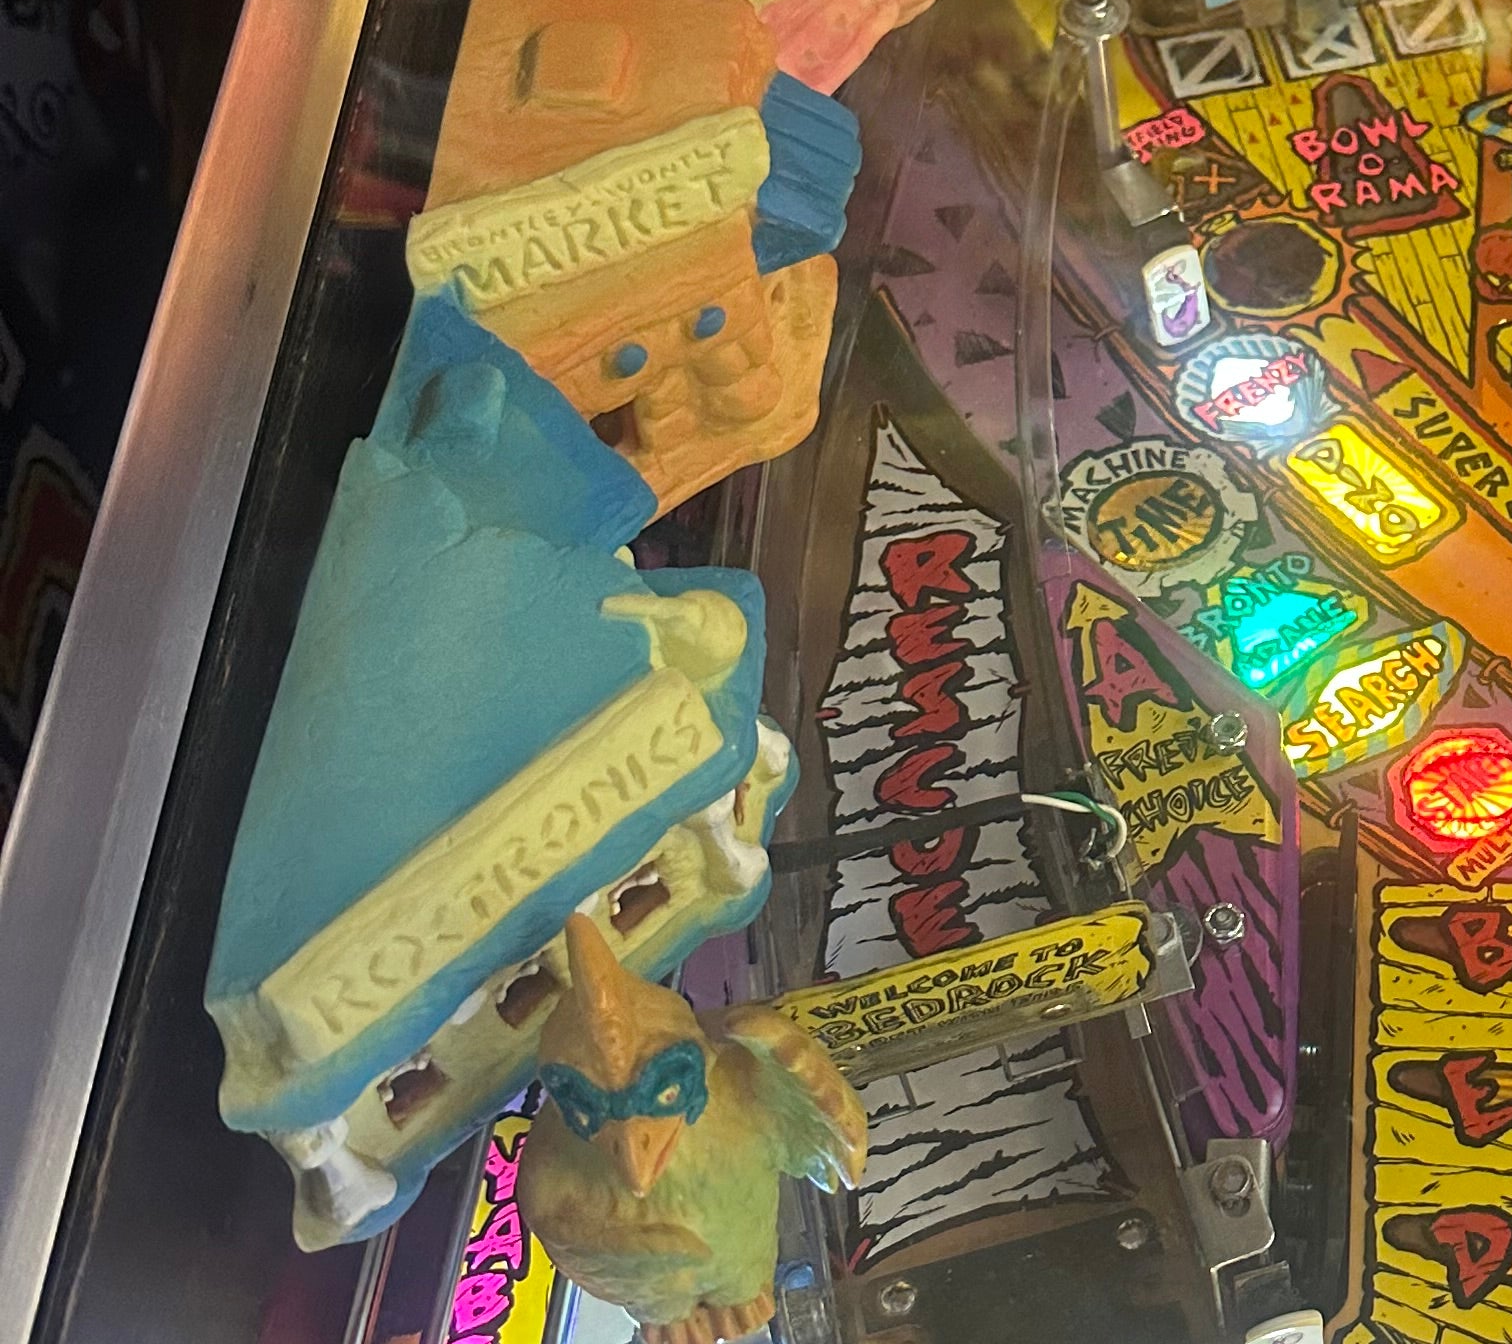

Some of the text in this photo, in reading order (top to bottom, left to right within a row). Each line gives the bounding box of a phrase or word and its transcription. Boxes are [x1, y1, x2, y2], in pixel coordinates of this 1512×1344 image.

[1288, 108, 1431, 164] BOWL
[1357, 152, 1386, 177] O
[1309, 161, 1460, 216] RAMA
[452, 168, 733, 296] MARKET
[1193, 352, 1309, 434] FRENZY
[1296, 436, 1421, 538] DINO
[1394, 393, 1509, 499] SUPER
[1061, 447, 1190, 536] MACHINE
[1096, 477, 1212, 555] TIME
[1284, 635, 1444, 759] SEARCH
[873, 529, 982, 959] RESCUE
[1119, 764, 1256, 840] CHOICE
[807, 948, 1112, 1050] BEDROCK
[808, 937, 1085, 1020] WELCOME TO
